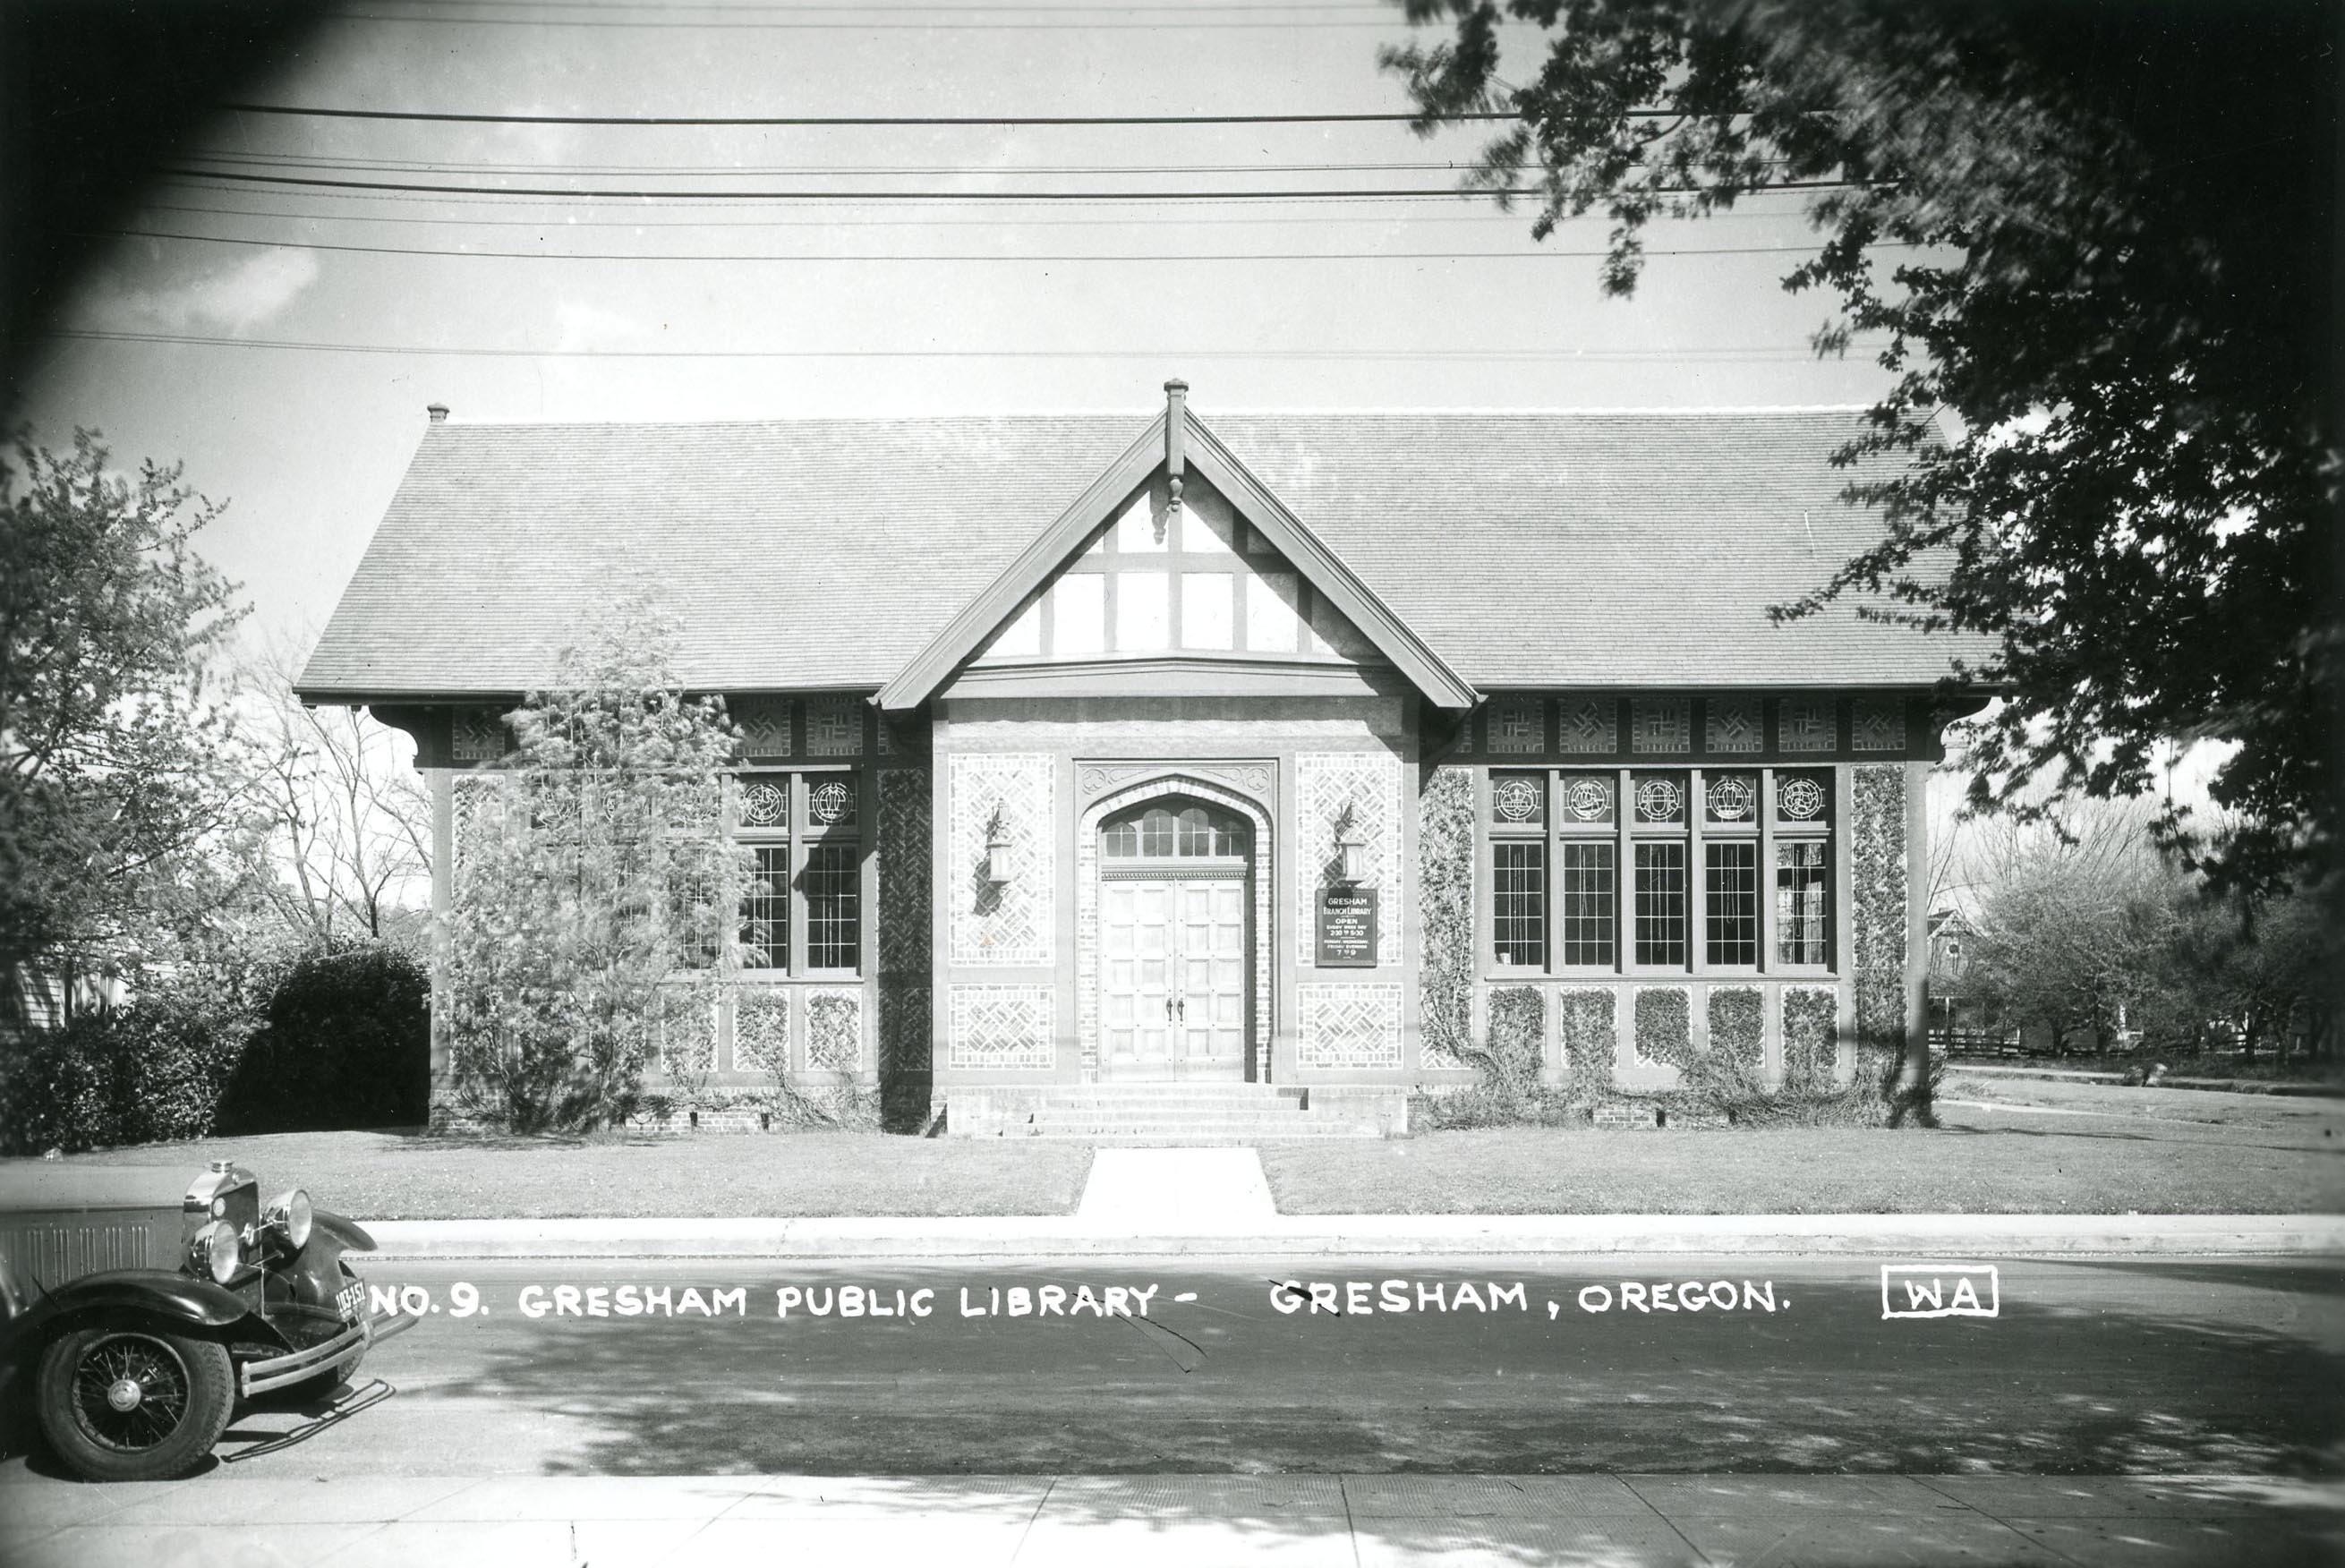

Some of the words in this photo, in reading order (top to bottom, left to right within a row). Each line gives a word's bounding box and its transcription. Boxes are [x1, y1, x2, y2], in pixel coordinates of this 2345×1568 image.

[1323, 907, 1346, 915] BRANCH
[1347, 907, 1372, 915] LIBRARY
[335, 1281, 366, 1313] 103-151
